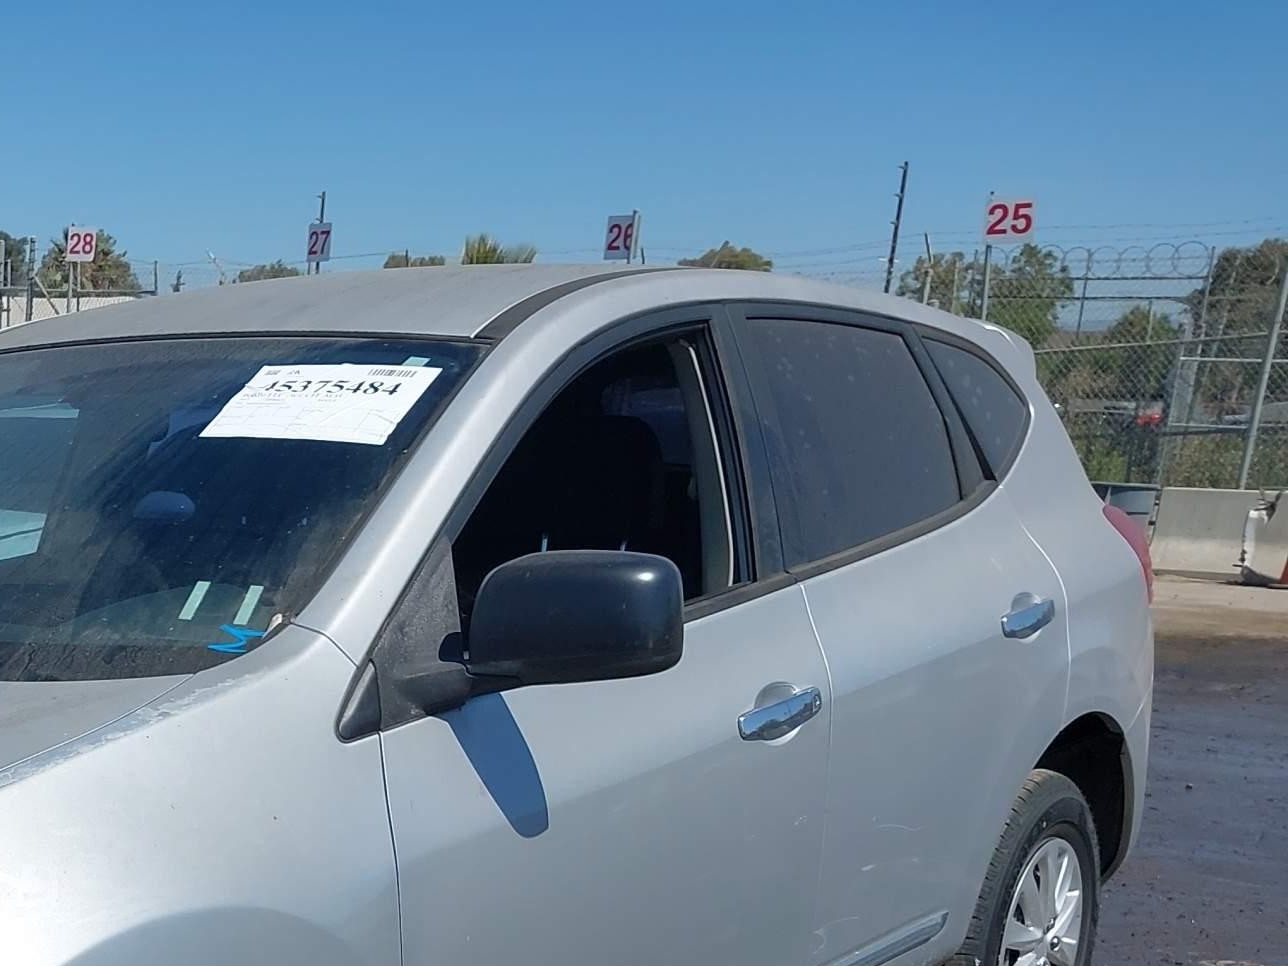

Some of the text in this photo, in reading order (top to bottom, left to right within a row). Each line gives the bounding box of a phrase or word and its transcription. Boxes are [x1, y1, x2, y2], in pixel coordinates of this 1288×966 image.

[986, 203, 1032, 235] 25
[69, 233, 93, 255] 28
[308, 230, 331, 255] 27
[607, 224, 633, 251] 26
[257, 380, 403, 396] 45375484
